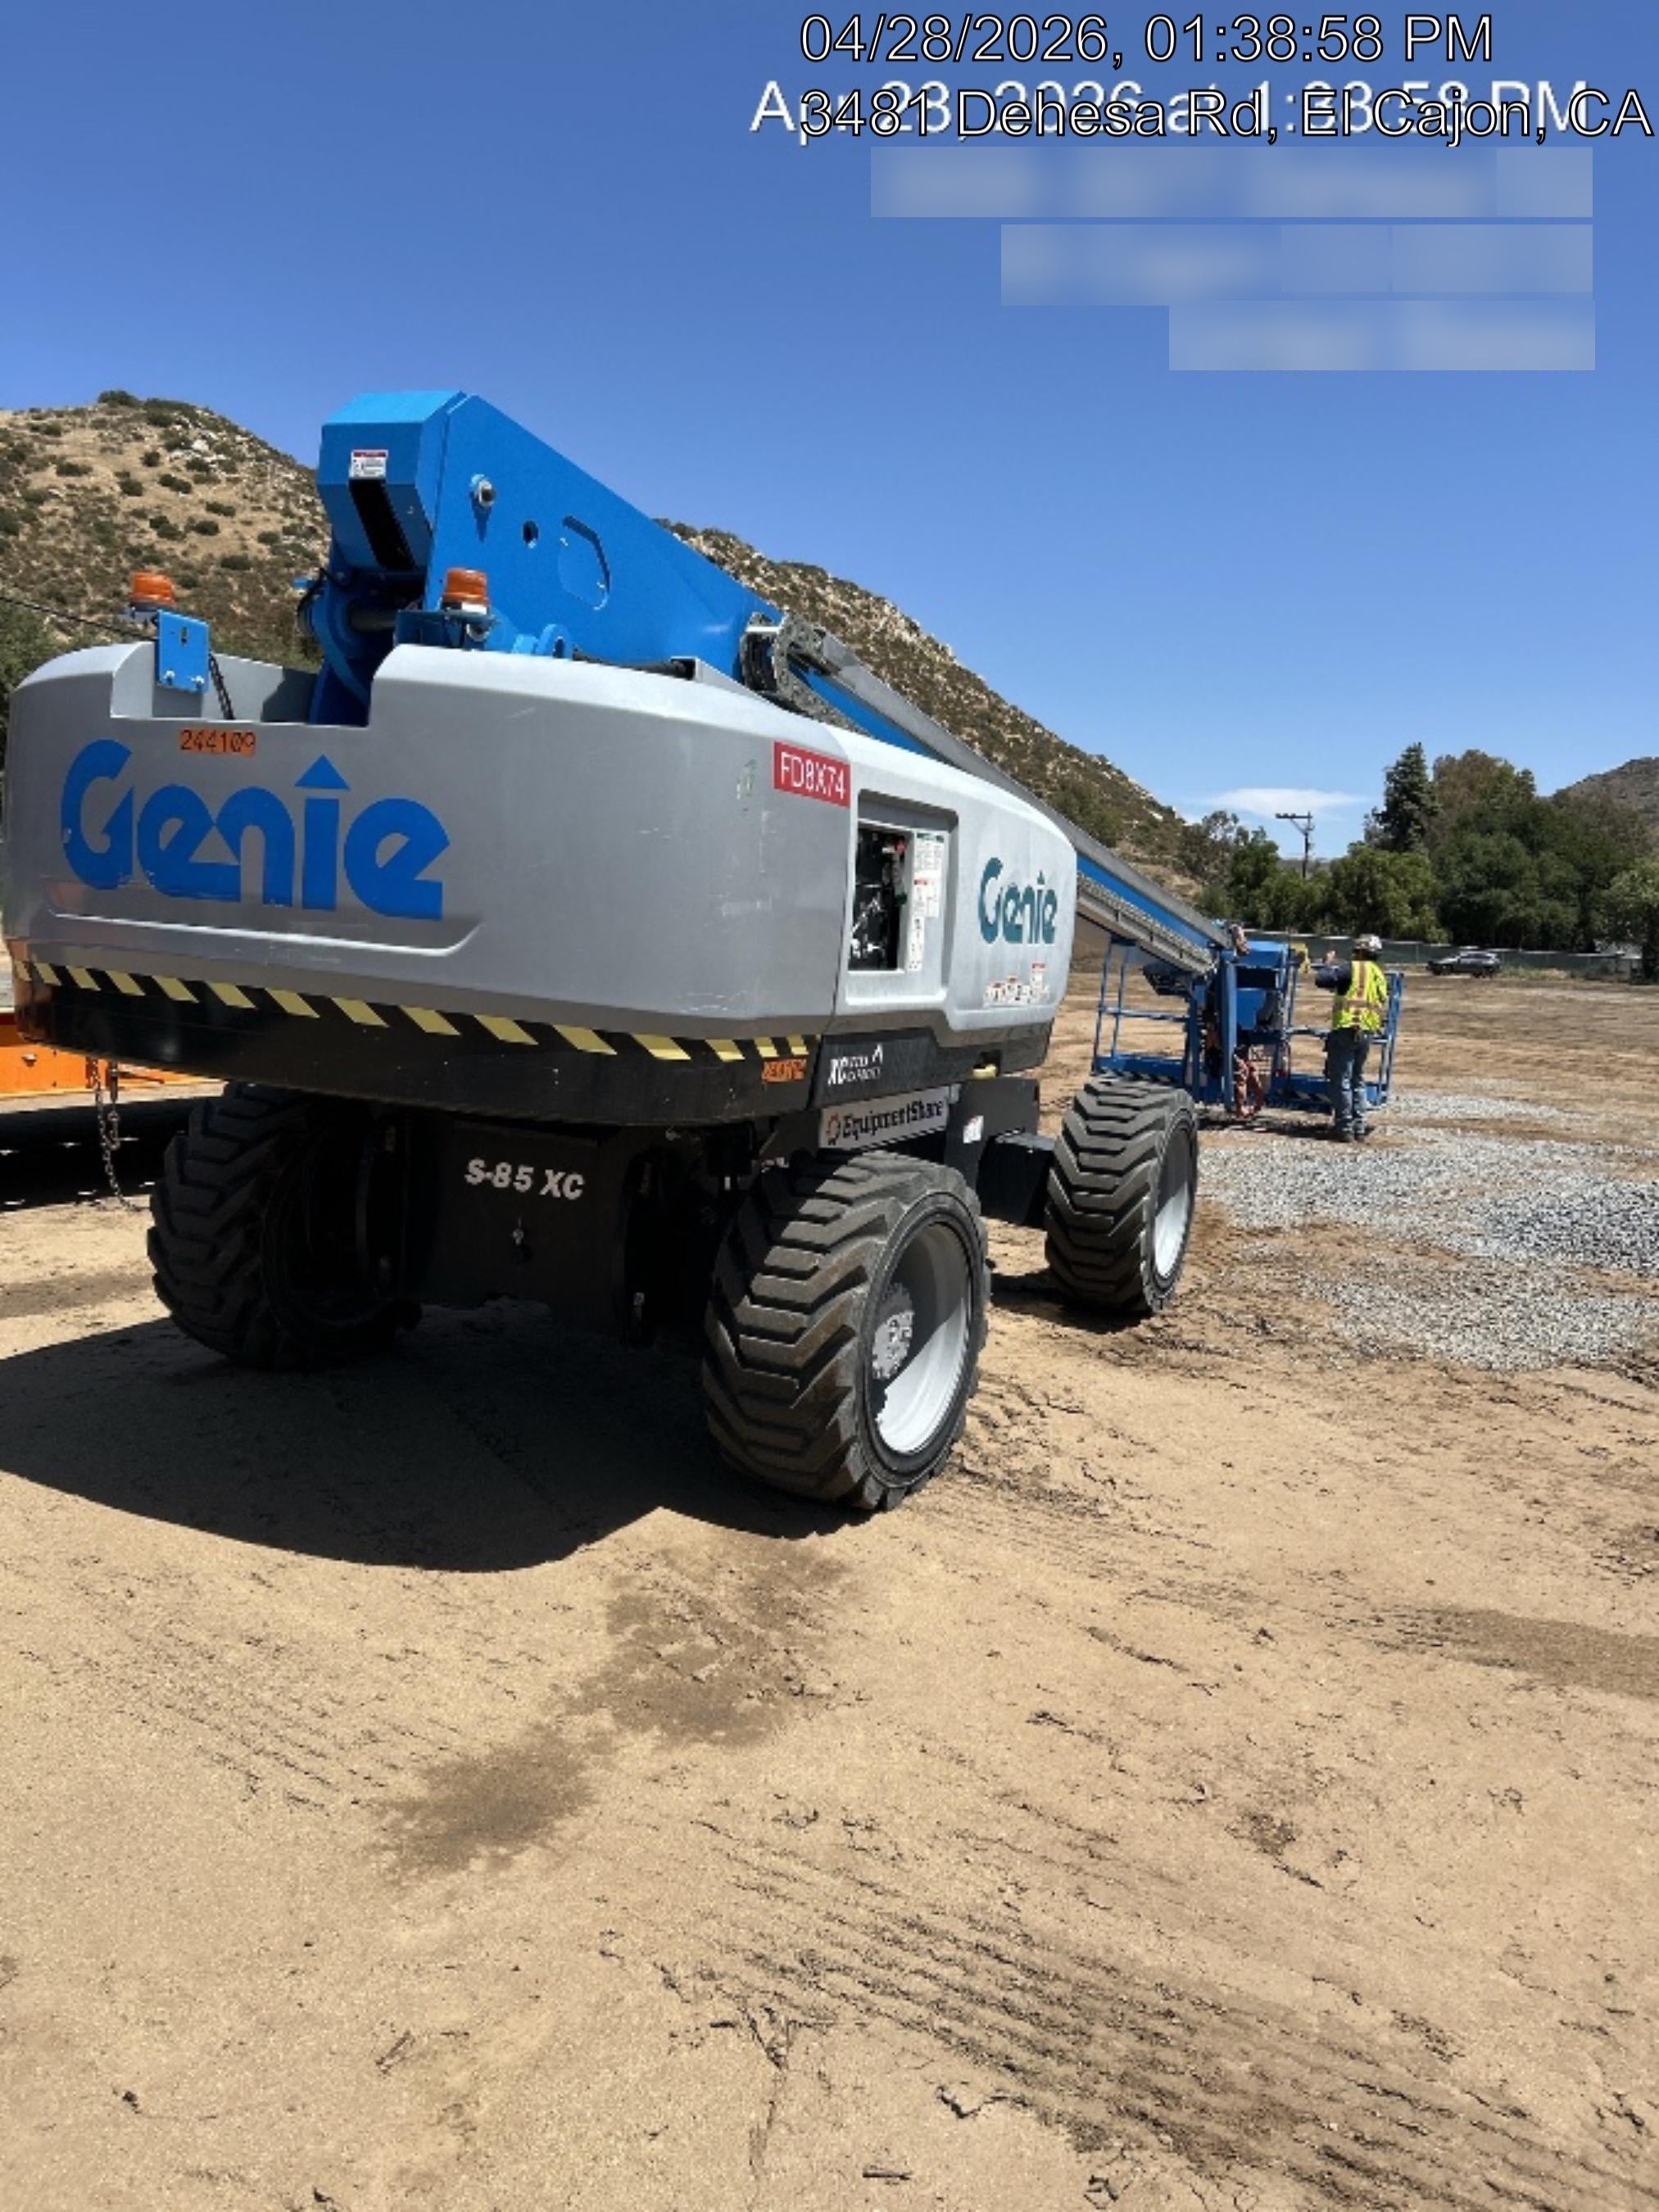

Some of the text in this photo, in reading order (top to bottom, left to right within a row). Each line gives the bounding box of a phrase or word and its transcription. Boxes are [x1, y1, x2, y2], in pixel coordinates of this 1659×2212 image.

[780, 751, 845, 800] FD8X74
[61, 739, 450, 920] Genie
[978, 857, 1058, 944] Genie
[464, 1158, 585, 1200] S-85 XC
